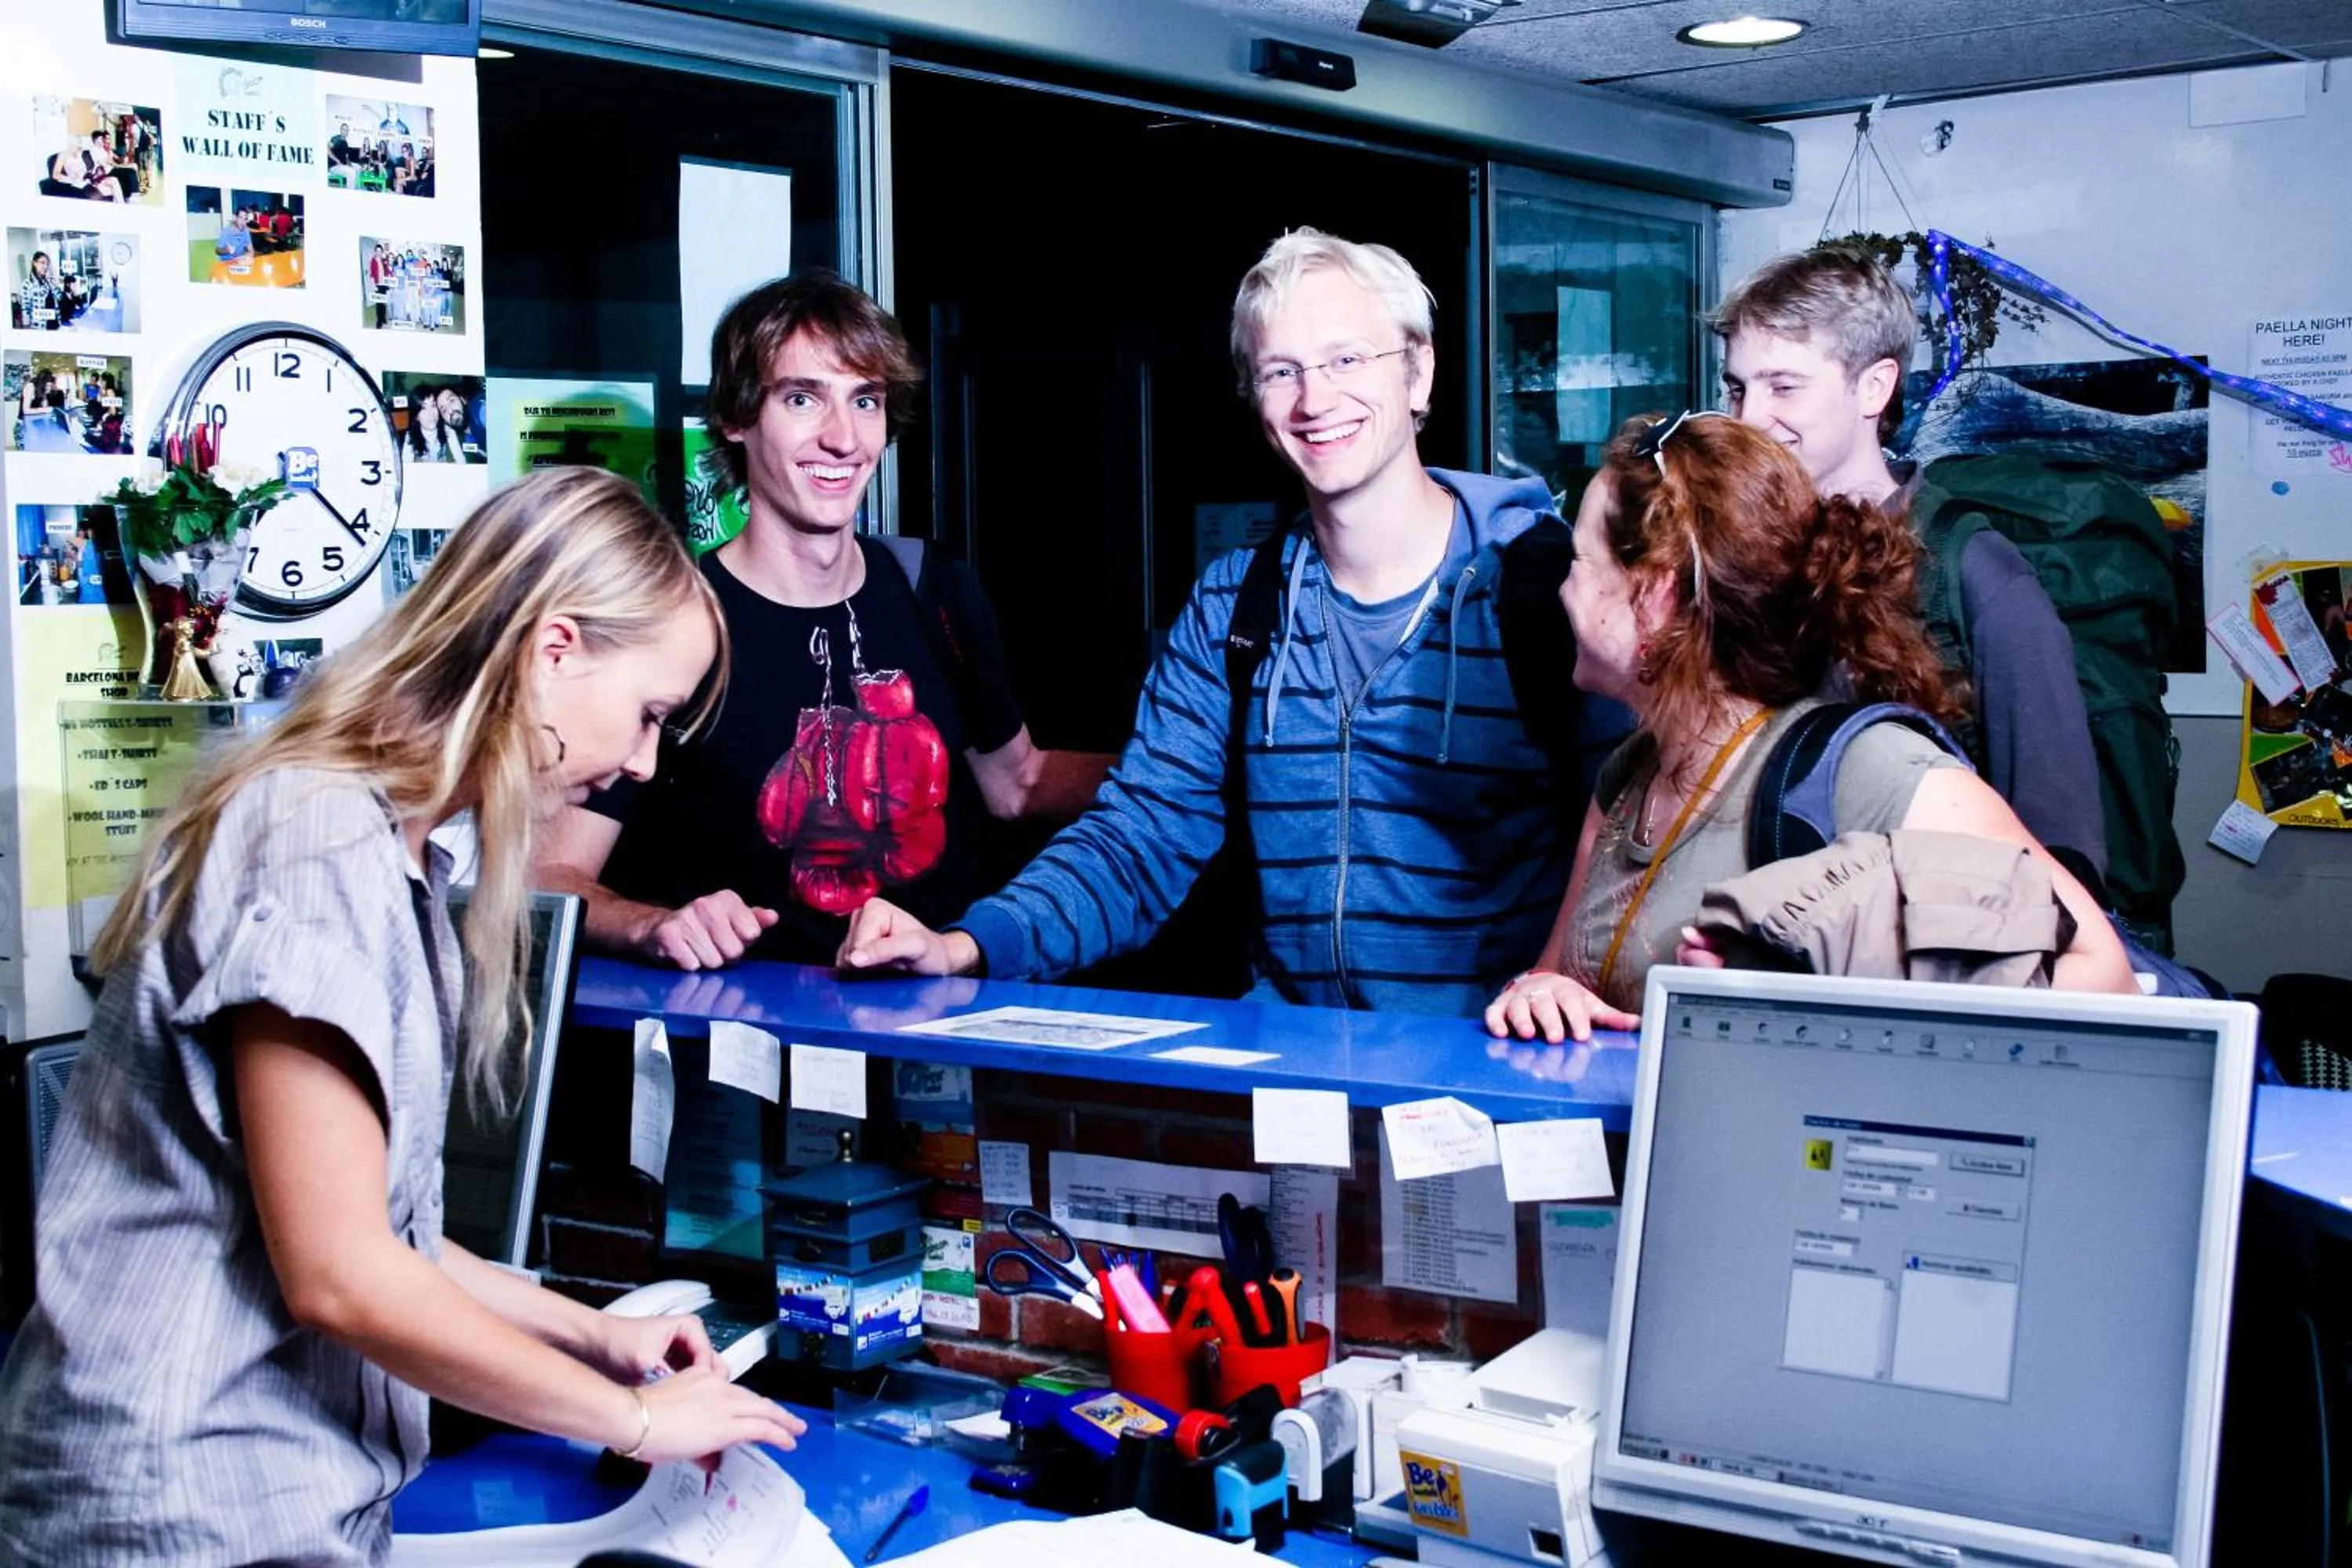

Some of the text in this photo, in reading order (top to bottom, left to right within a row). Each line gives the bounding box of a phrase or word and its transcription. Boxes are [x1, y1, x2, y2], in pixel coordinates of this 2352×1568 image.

[291, 17, 327, 29] BOSCH
[182, 136, 314, 165] WALL OF FAME
[2256, 317, 2352, 334] PAELLA NIGHT
[2283, 334, 2325, 347] HERE!
[274, 352, 300, 378] 12
[237, 367, 250, 392] 11
[327, 368, 331, 392] 1
[205, 404, 227, 428] 10
[347, 408, 368, 433] 2
[361, 461, 381, 485] 3
[350, 508, 370, 532] 4
[248, 546, 260, 573] 7
[322, 547, 344, 571] 5
[281, 561, 303, 586] 6
[1406, 1462, 1435, 1486] Be
